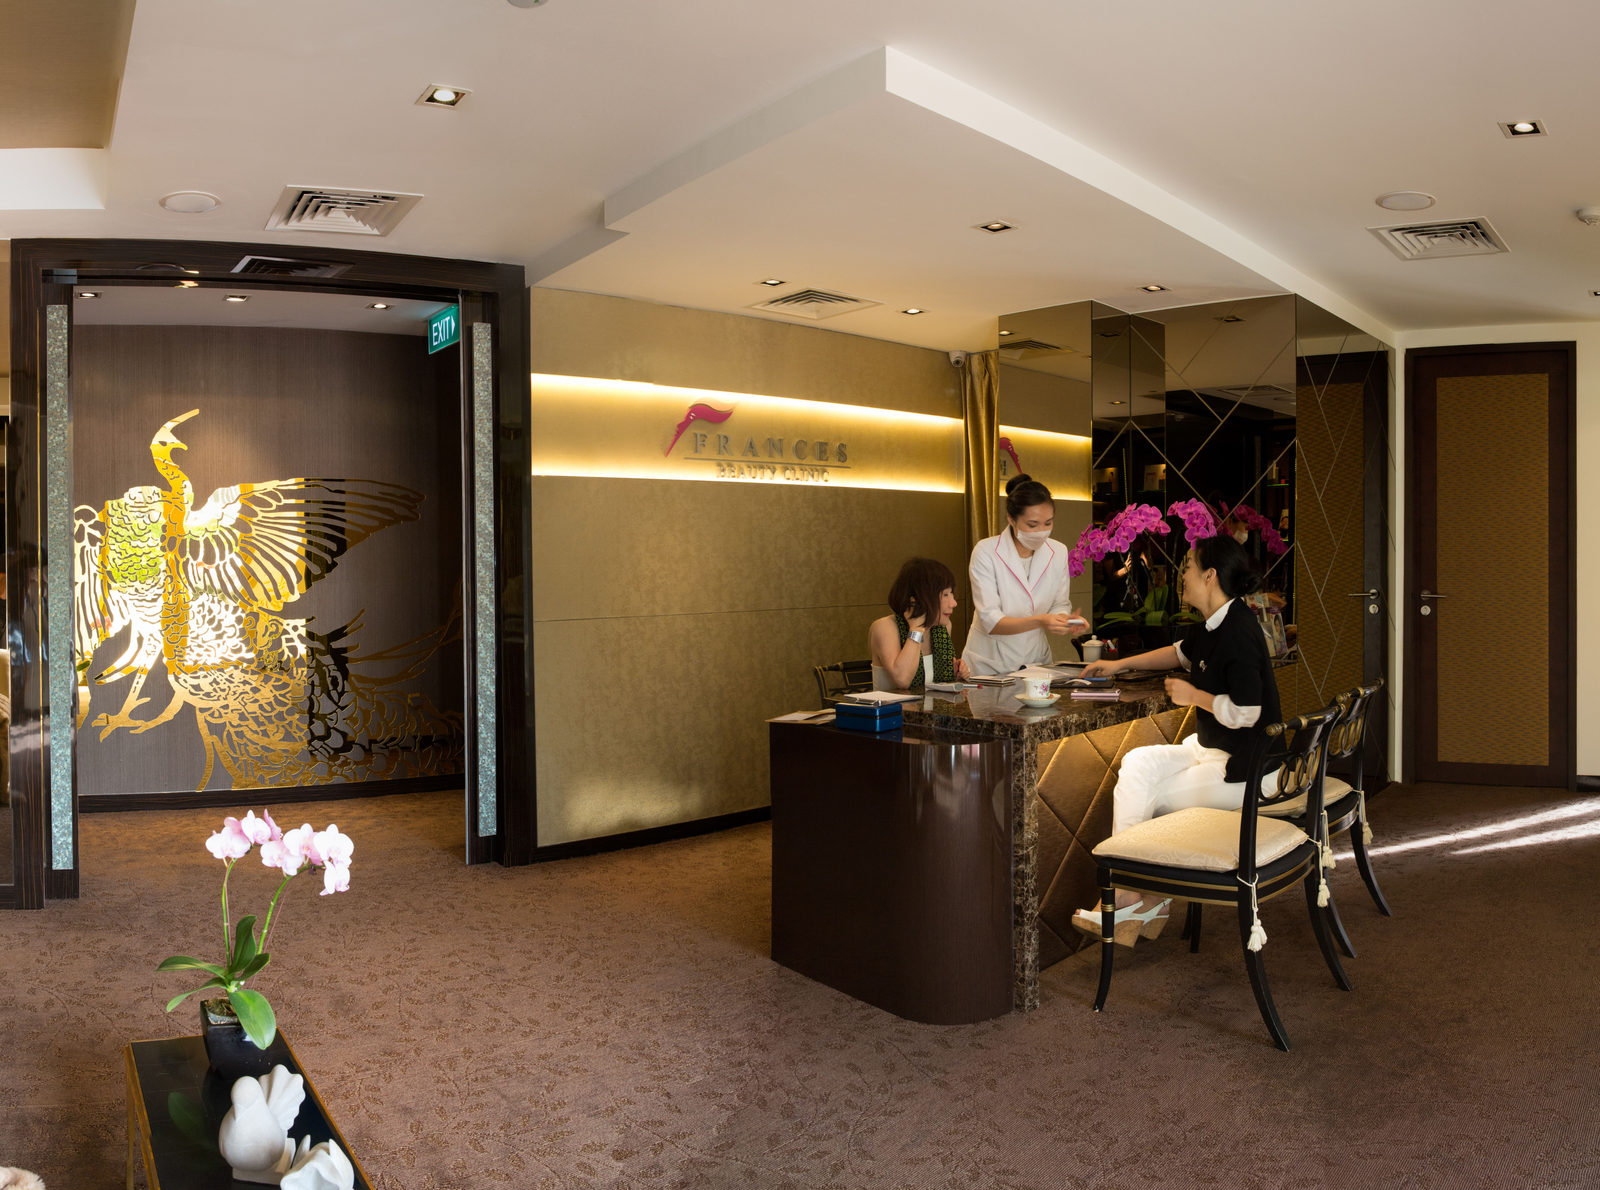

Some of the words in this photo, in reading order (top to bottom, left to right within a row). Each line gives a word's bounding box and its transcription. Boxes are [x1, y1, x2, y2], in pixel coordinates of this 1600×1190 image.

[432, 315, 451, 346] EXIT
[693, 432, 848, 463] FRANCES
[716, 463, 777, 479] BEAUTY
[783, 467, 830, 482] CLINIC
